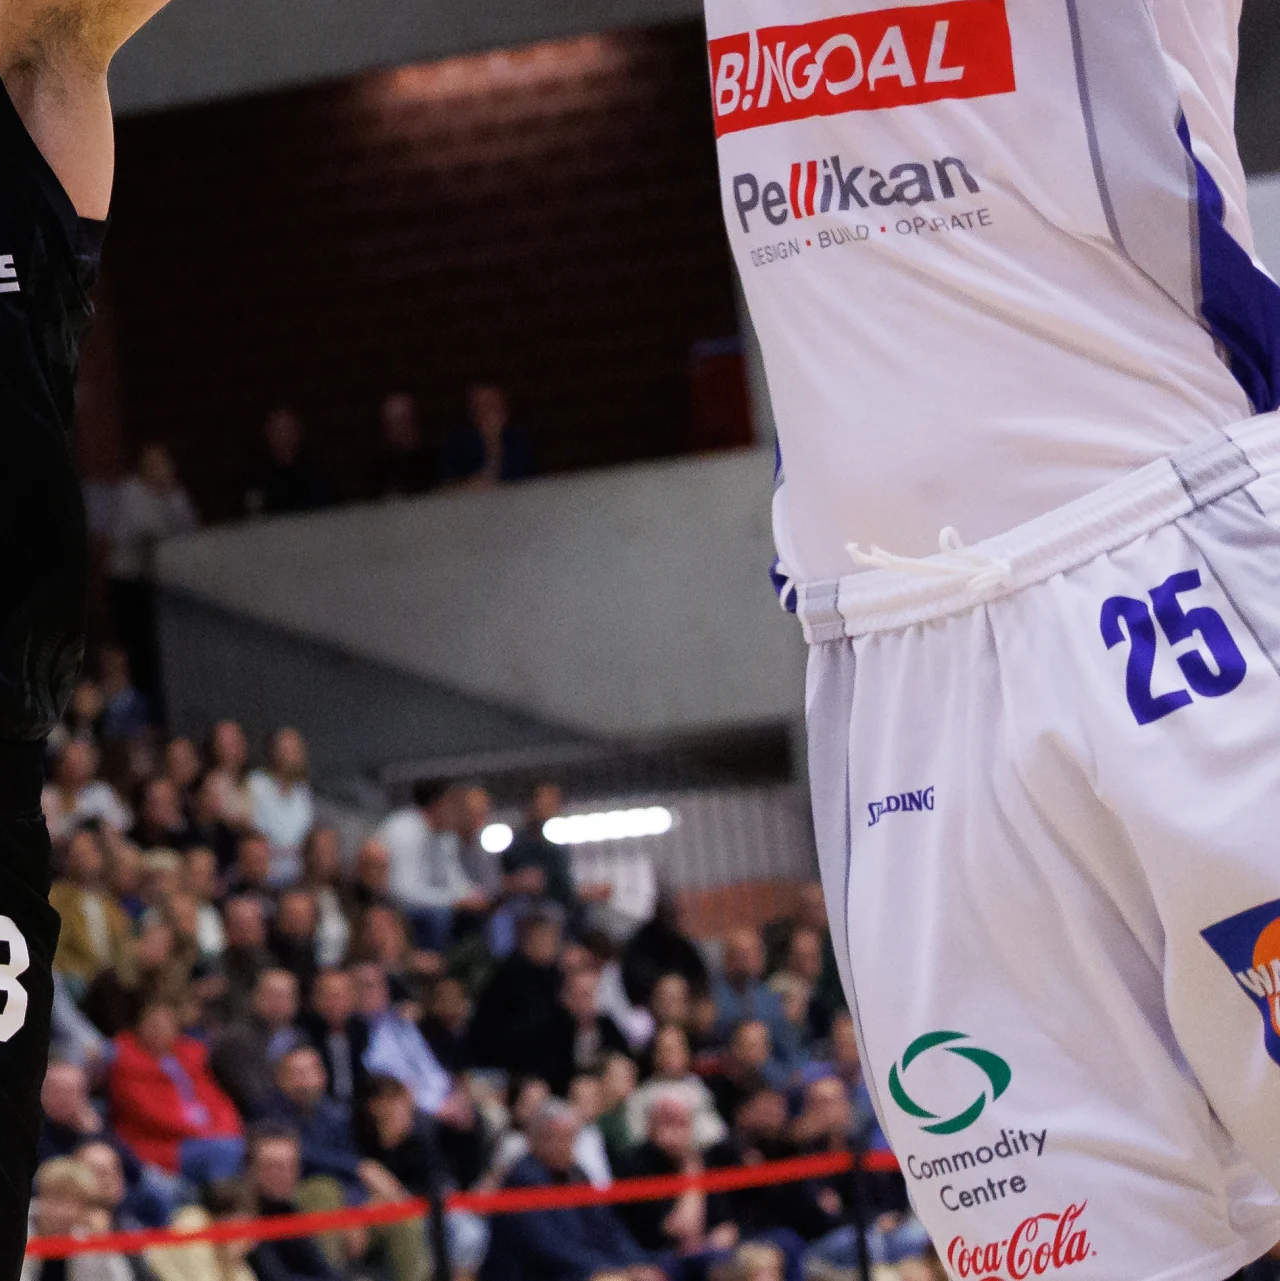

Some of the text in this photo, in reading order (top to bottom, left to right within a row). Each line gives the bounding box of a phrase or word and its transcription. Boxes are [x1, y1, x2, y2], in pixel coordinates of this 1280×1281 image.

[750, 237, 800, 268] DESIGN
[818, 223, 870, 249] BUILD
[1099, 568, 1248, 727] 25
[907, 1128, 1048, 1181] Commodity
[939, 1173, 1028, 1212] Centre
[947, 1199, 1092, 1280] Coca-Cola
